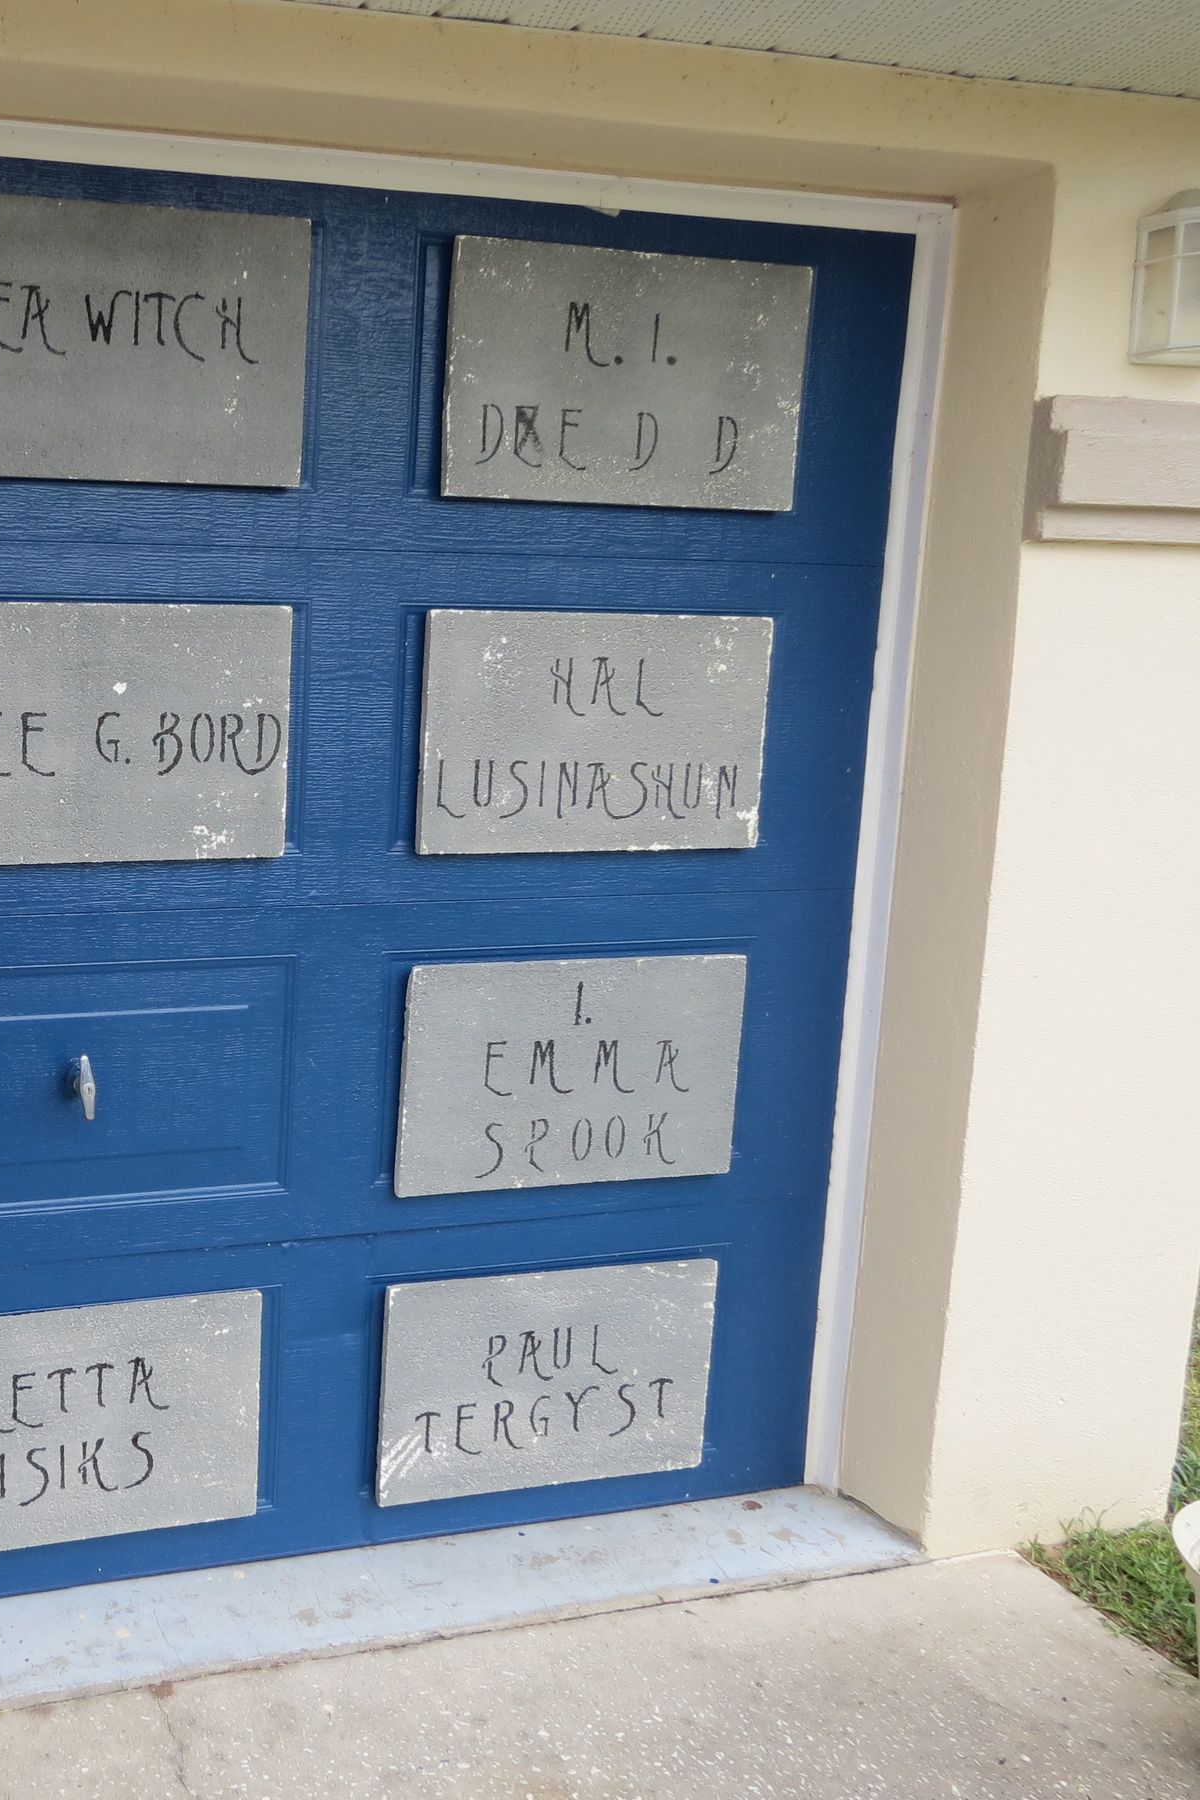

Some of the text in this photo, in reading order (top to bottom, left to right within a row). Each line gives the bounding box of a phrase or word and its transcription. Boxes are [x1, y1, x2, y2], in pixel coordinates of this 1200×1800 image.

[84, 290, 259, 365] WITCH
[550, 656, 664, 717] HAL
[152, 711, 283, 778] BORD
[436, 758, 738, 820] LUSINASHUN
[484, 1039, 690, 1097] EMMA
[474, 1111, 676, 1179] SPOOK
[482, 1324, 618, 1388] PAUL
[415, 1377, 674, 1455] TERGYST
